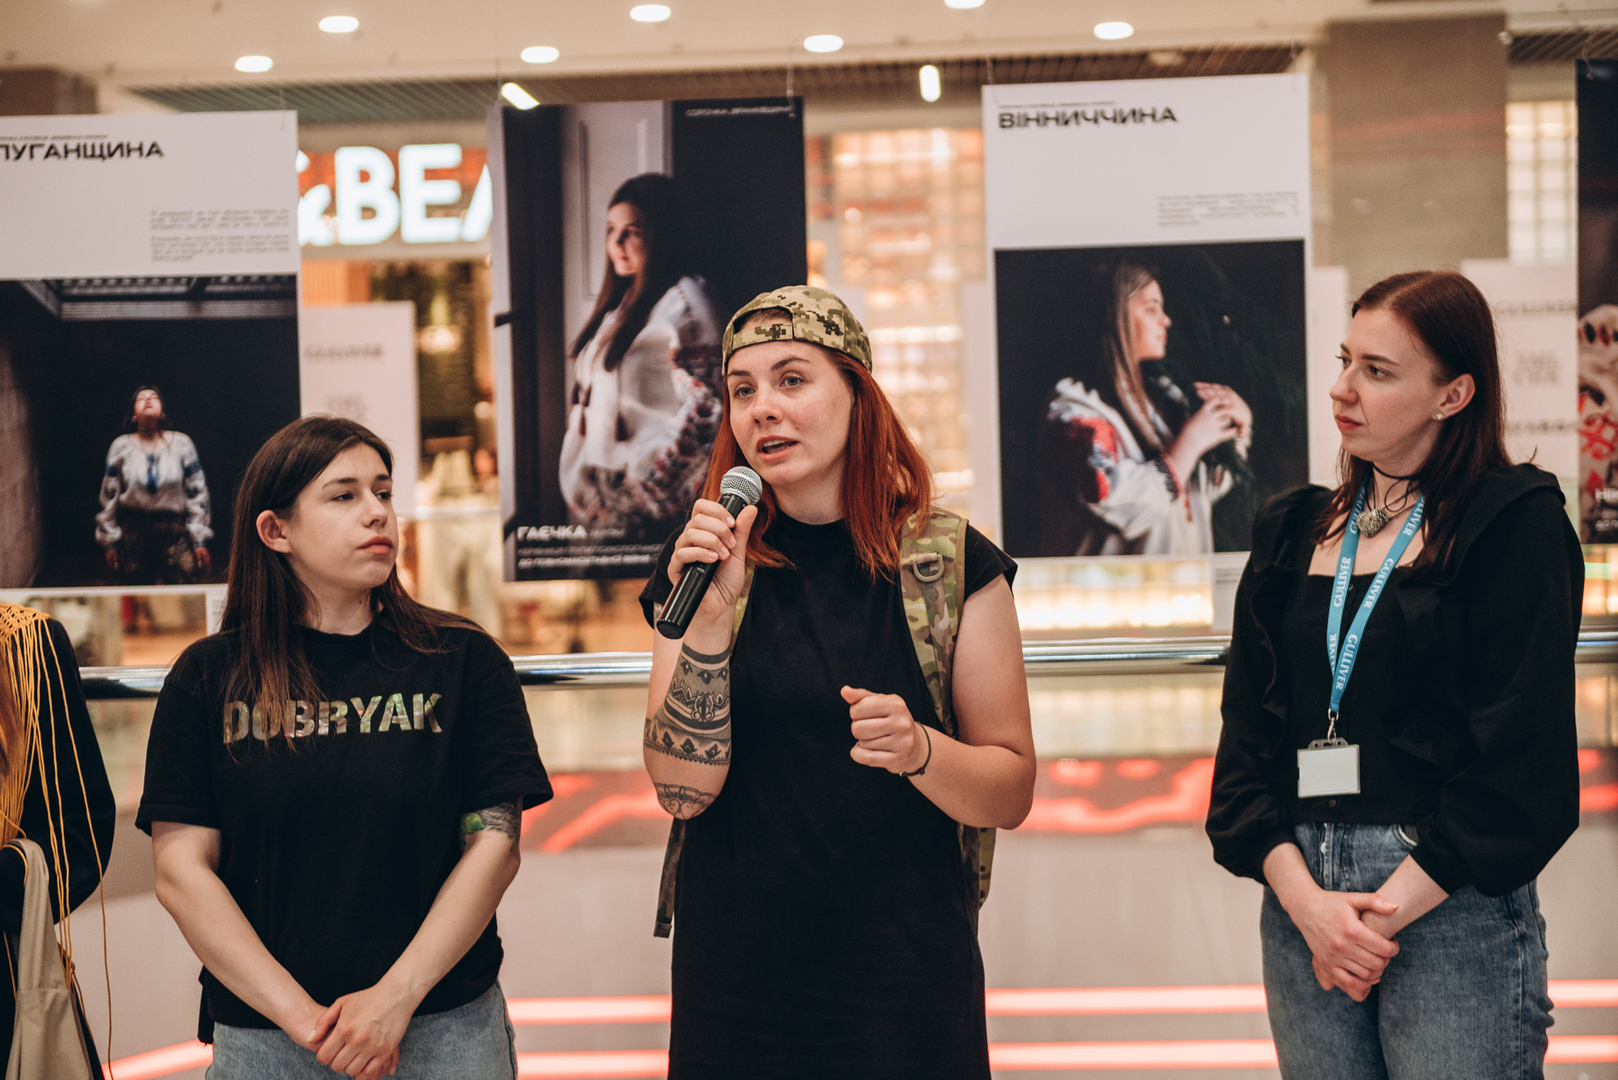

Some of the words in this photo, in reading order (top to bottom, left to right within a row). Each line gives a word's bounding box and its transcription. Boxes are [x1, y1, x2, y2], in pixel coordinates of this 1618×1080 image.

[999, 107, 1177, 129] ВІННИЧЧИНА
[1333, 556, 1352, 608] GULLIVER
[1363, 558, 1394, 609] GULLIVER
[1335, 633, 1359, 691] GULLIVER
[222, 692, 443, 744] DOBRYAK
